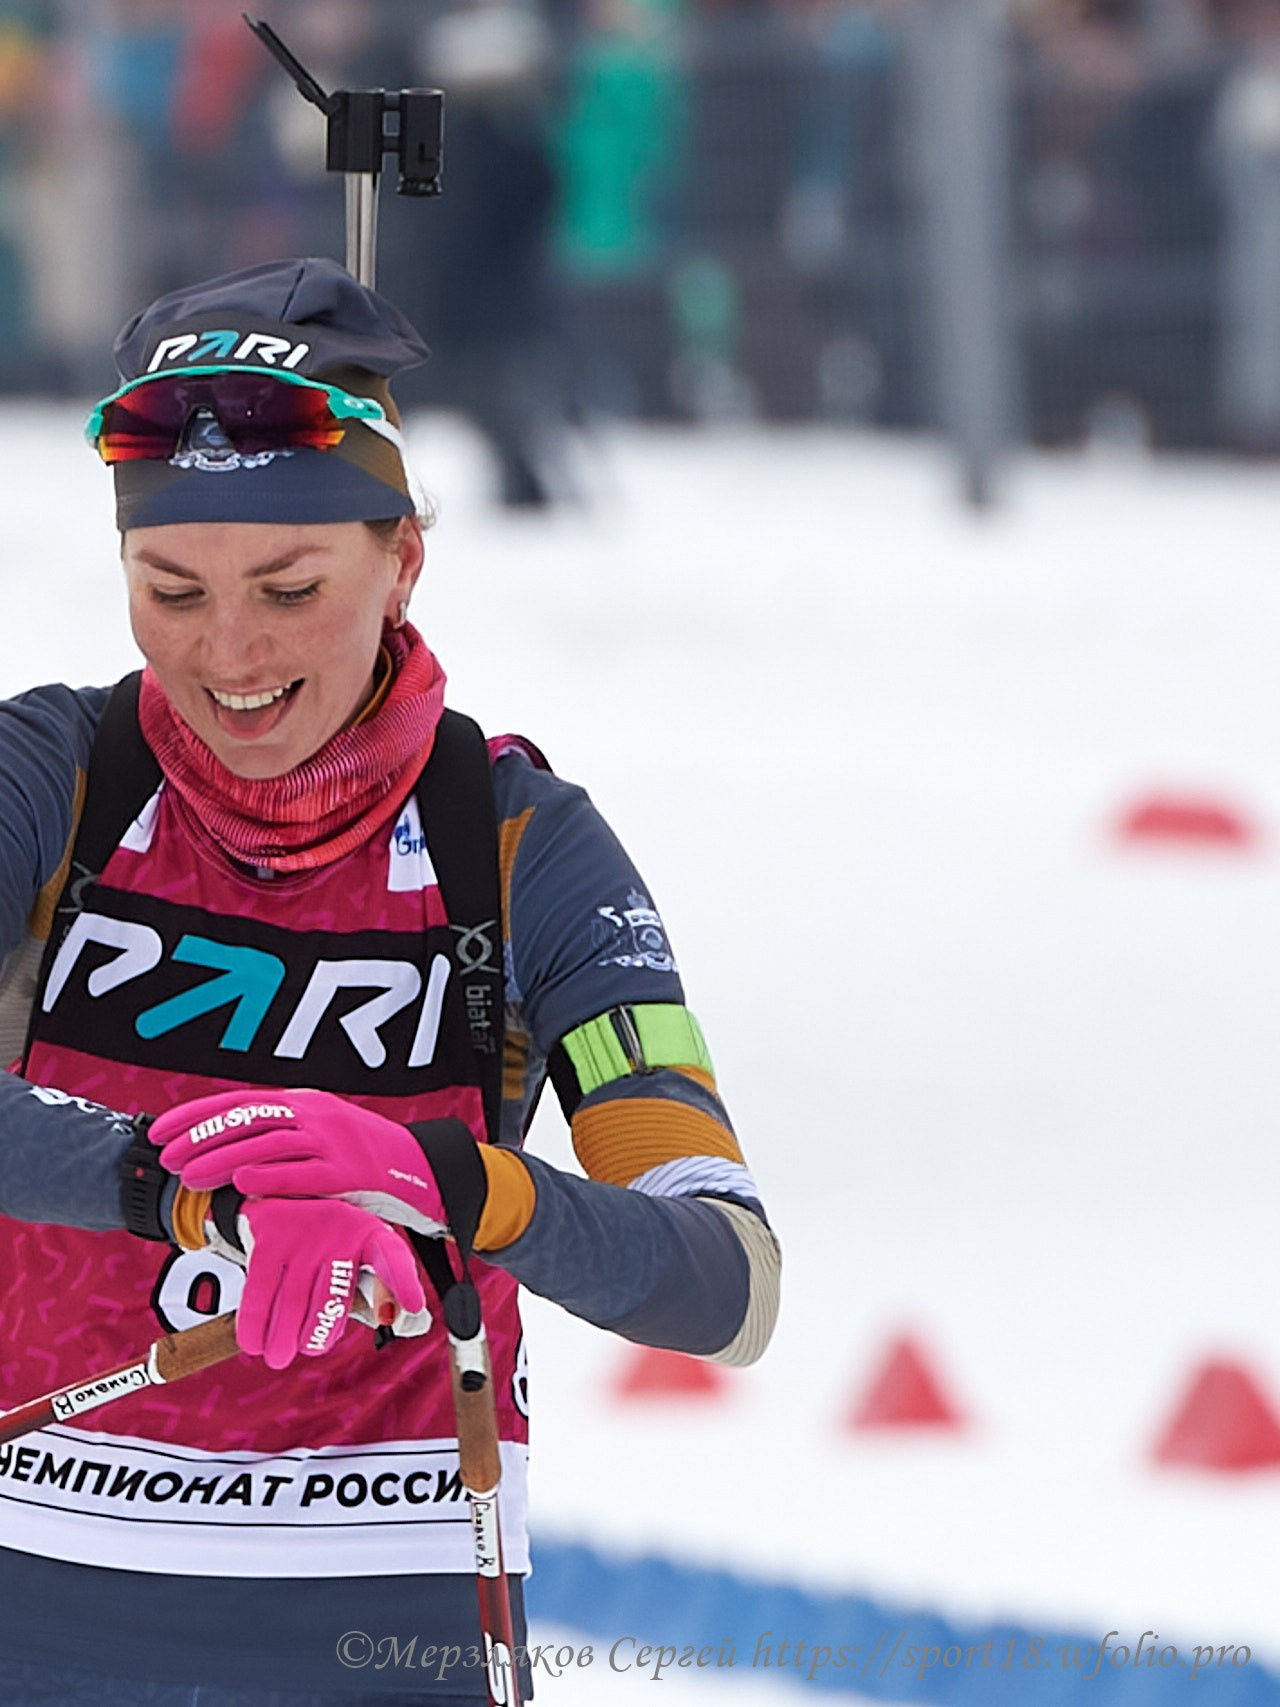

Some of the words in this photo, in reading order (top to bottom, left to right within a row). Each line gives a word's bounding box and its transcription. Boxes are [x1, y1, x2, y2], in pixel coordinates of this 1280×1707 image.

[147, 330, 310, 372] PARI
[43, 911, 452, 1069] PARI
[299, 1468, 470, 1508] РОССИ
